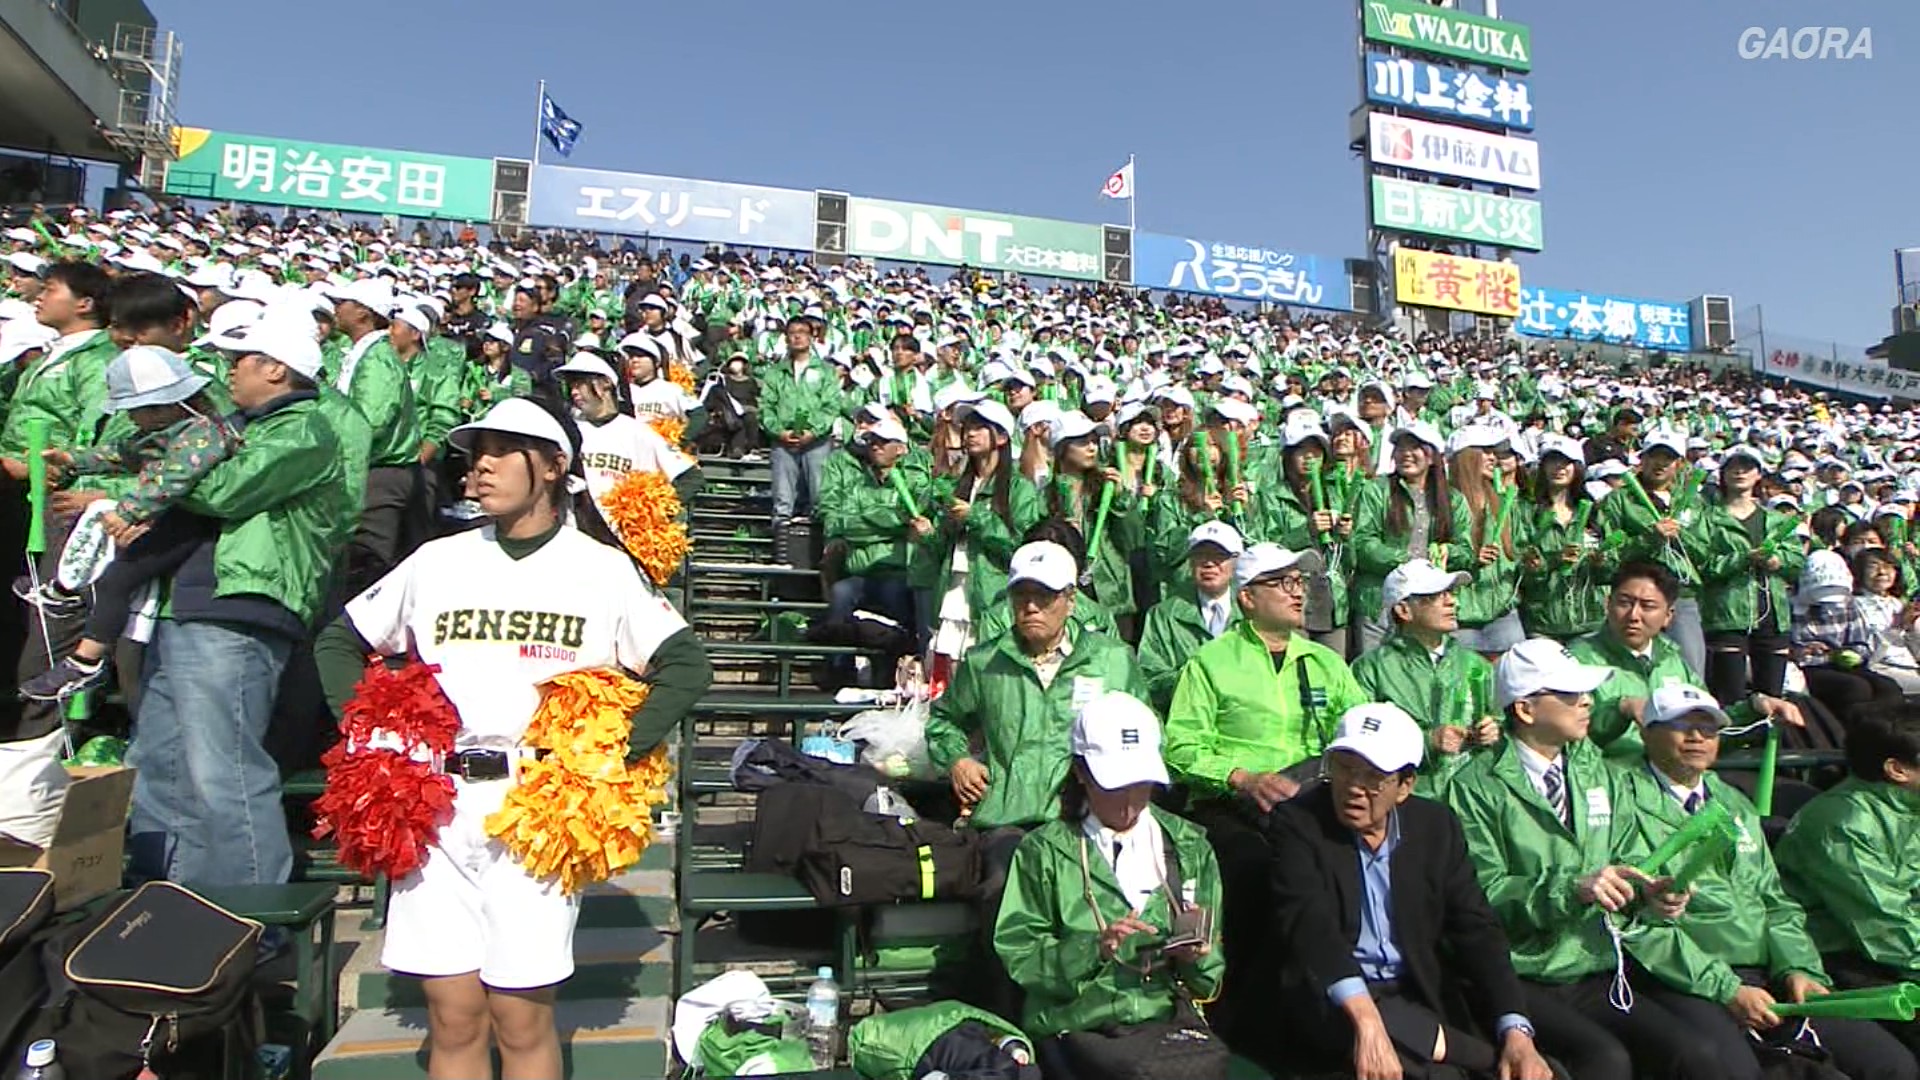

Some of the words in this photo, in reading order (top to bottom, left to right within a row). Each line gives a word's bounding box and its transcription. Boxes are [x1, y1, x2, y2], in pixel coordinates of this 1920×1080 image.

[1413, 13, 1528, 62] WAZUKA
[1374, 59, 1532, 125] 川上塗料
[222, 143, 446, 208] 明治安田
[1421, 134, 1532, 176] 伊藤ハム
[576, 186, 771, 234] エスリード
[855, 204, 1013, 263] DNT
[1384, 182, 1534, 243] 日新火災
[1212, 259, 1322, 303] ろうきん
[1426, 258, 1518, 311] 黄桜
[434, 608, 586, 648] SENSHU
[519, 644, 577, 662] MATSUDO
